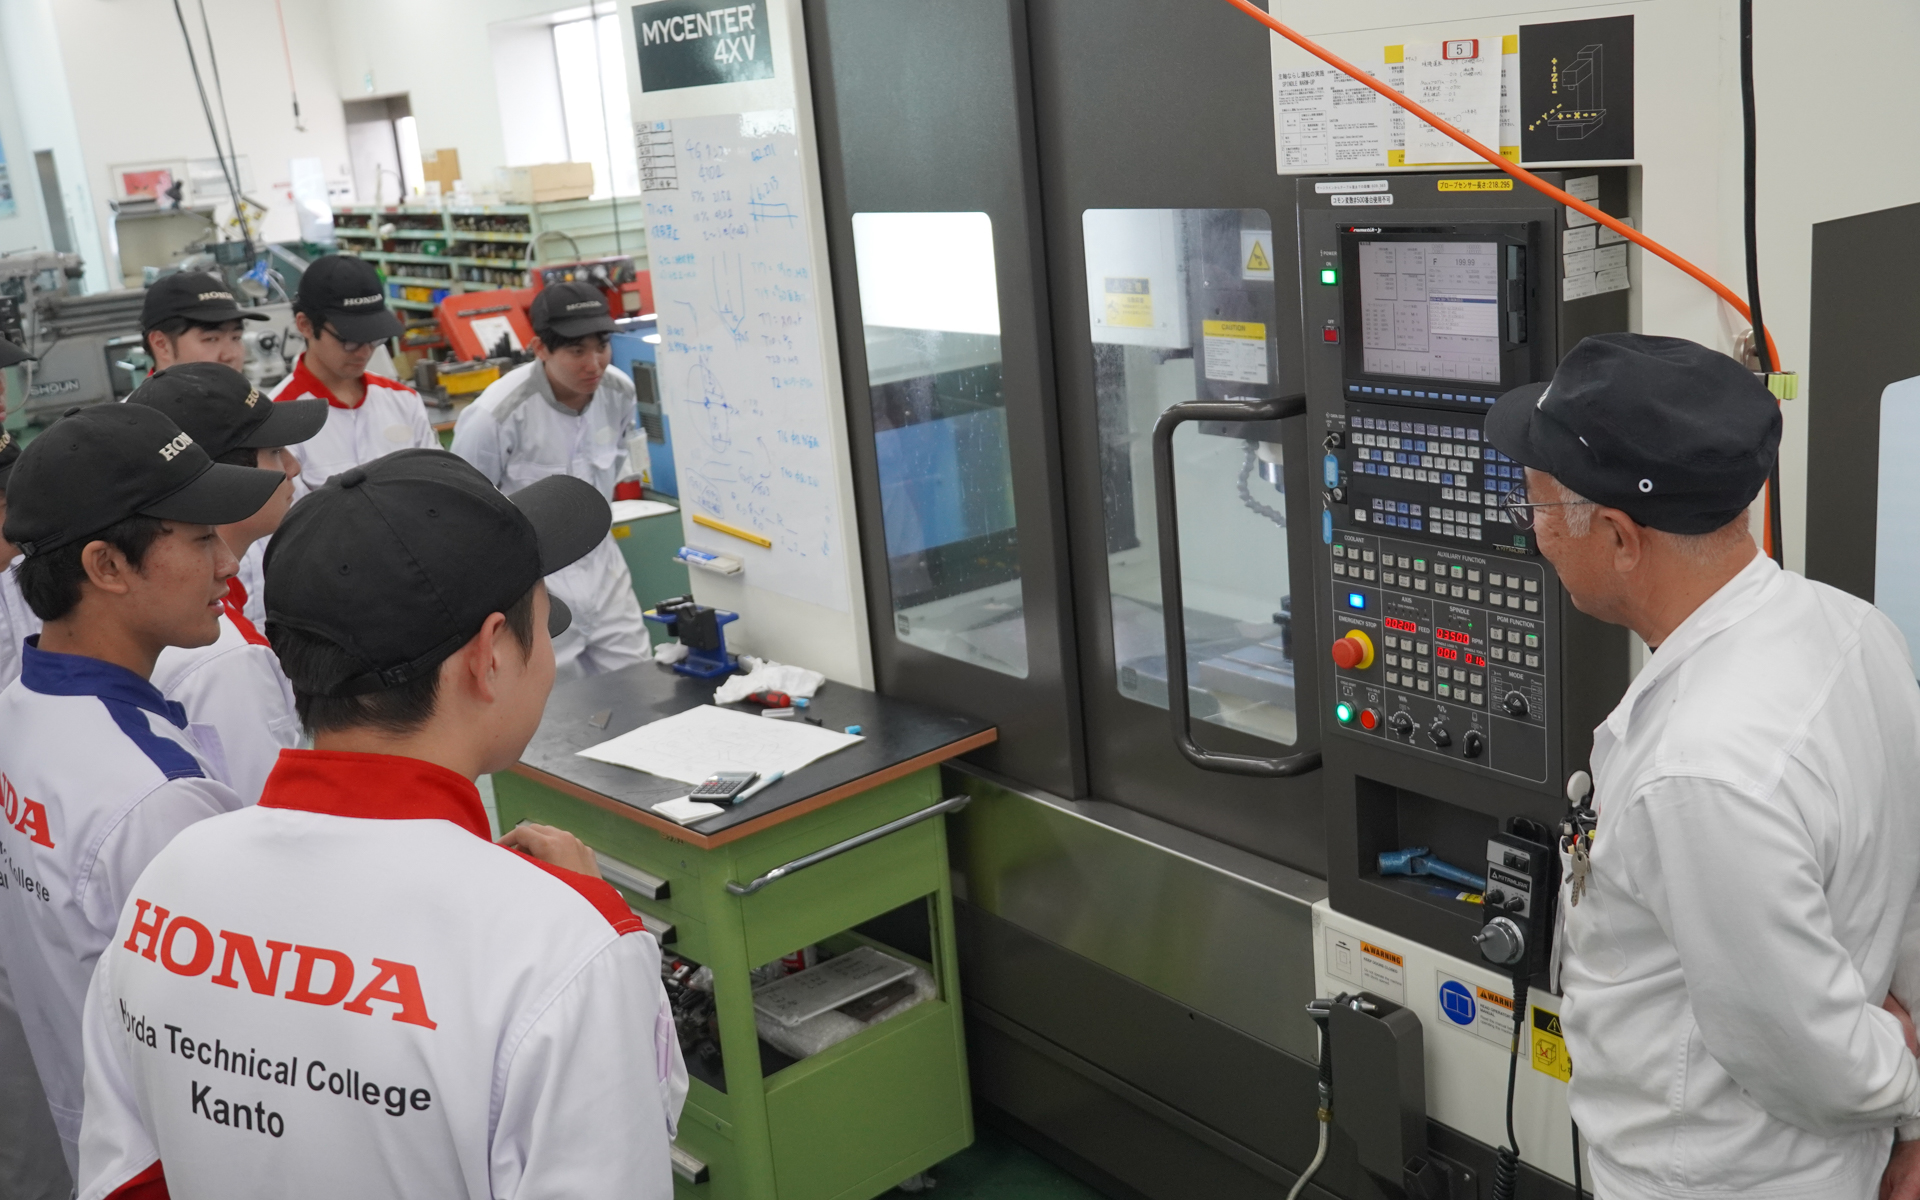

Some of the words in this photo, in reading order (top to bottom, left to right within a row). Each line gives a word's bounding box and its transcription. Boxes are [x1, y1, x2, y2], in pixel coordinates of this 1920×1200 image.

[642, 5, 755, 46] MYCENTER
[714, 35, 756, 64] 4XV
[1456, 44, 1463, 55] 5
[1551, 73, 1558, 82] Z
[1455, 258, 1476, 266] 199.99
[343, 293, 383, 306] HONDA
[566, 300, 603, 311] HONDA
[1221, 323, 1246, 332] CAUTION
[1344, 535, 1364, 543] COOLANT
[1437, 551, 1461, 560] AUXILIARY
[1462, 555, 1486, 565] FUNCTION
[1401, 596, 1412, 604] AXIS
[1449, 606, 1470, 615] SPINDLE
[1338, 615, 1364, 626] EMERGENCY
[1365, 620, 1377, 628] STOP
[1385, 617, 1416, 633] 00200
[1418, 626, 1430, 634] FEED
[1510, 618, 1534, 628] FUNCTION
[1436, 628, 1469, 645] 03500
[1471, 637, 1484, 645] RPM
[1437, 647, 1457, 660] 000
[1508, 671, 1524, 679] MODE
[1369, 945, 1401, 964] WARNING
[123, 898, 438, 1030] HONDA
[164, 1023, 297, 1087] Technical
[306, 1060, 432, 1117] College
[191, 1080, 284, 1138] Kanto
